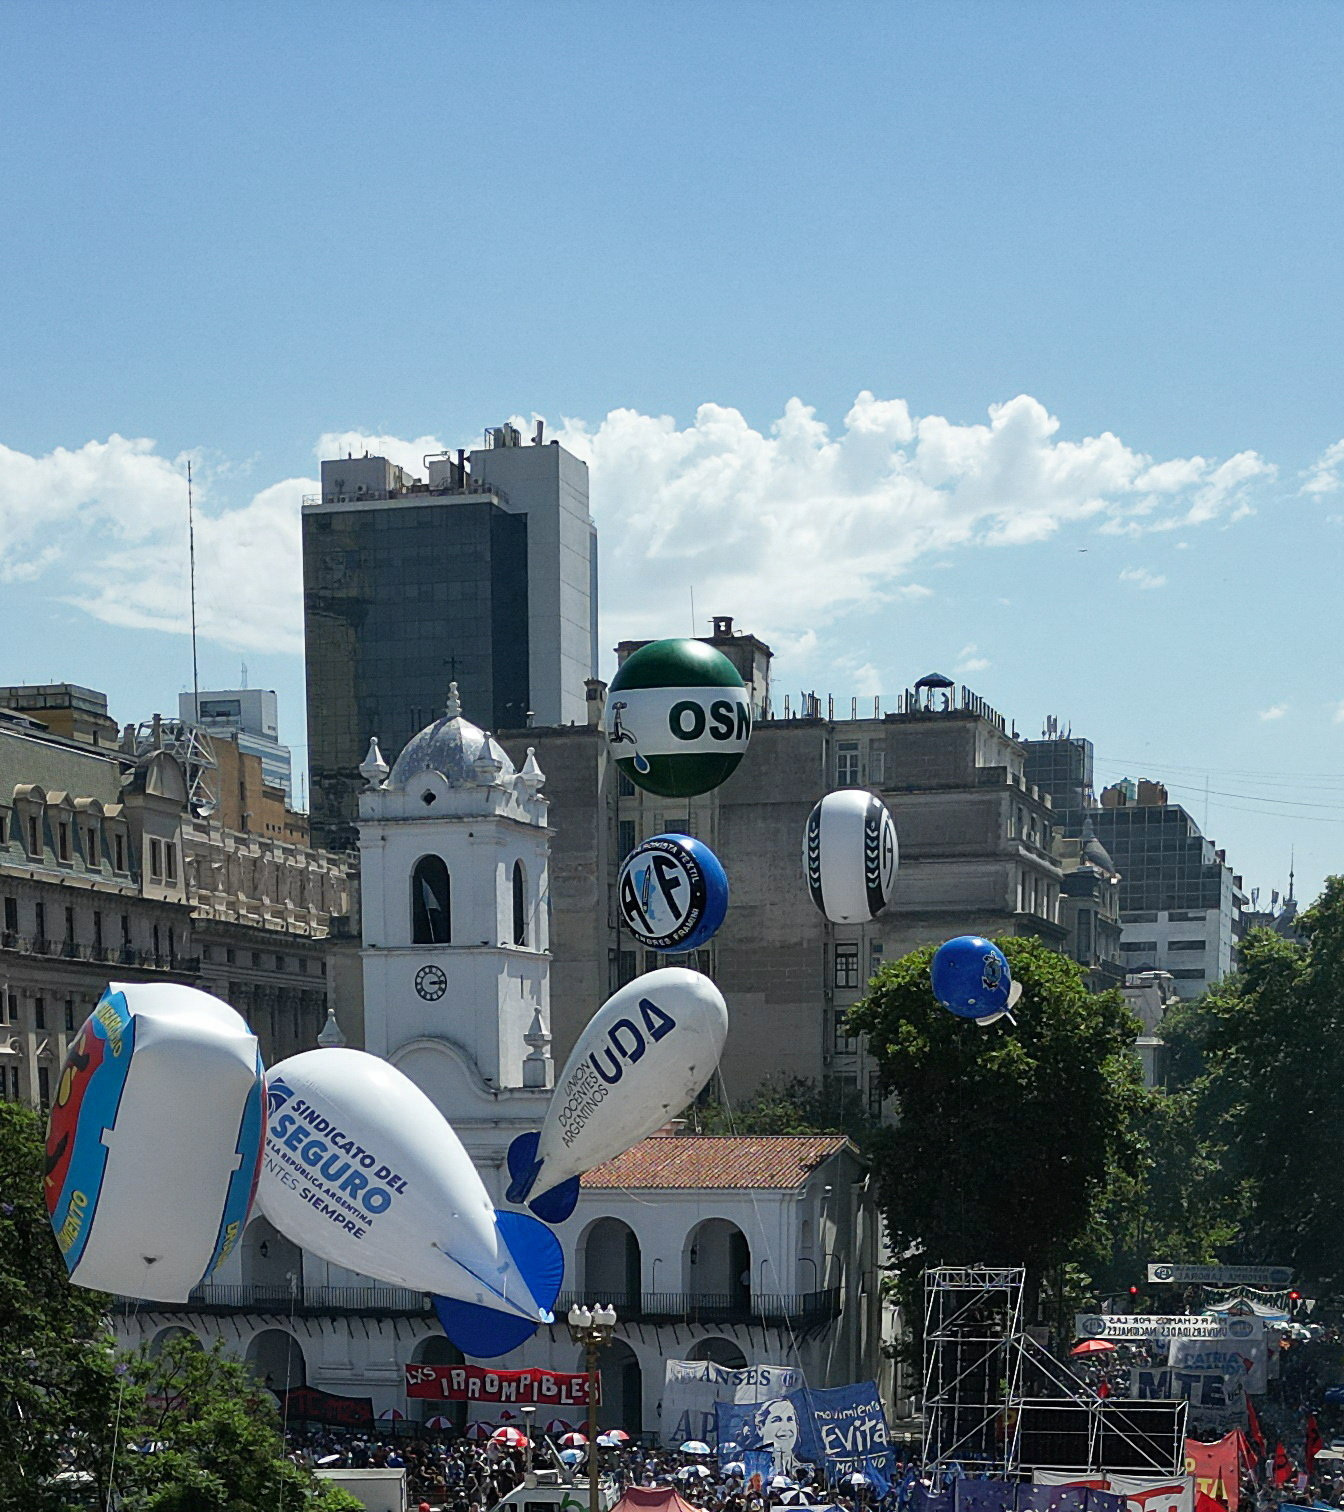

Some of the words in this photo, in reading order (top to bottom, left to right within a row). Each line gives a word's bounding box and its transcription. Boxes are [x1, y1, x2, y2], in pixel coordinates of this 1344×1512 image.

[589, 998, 676, 1085] UDA
[558, 1071, 598, 1127] DOCENTES
[562, 1084, 608, 1148] ARGENTINOS
[270, 1114, 391, 1214] SEGURO
[291, 1100, 375, 1168] SINDICATO
[374, 1165, 408, 1195] DEL
[698, 1367, 771, 1387] ANSES
